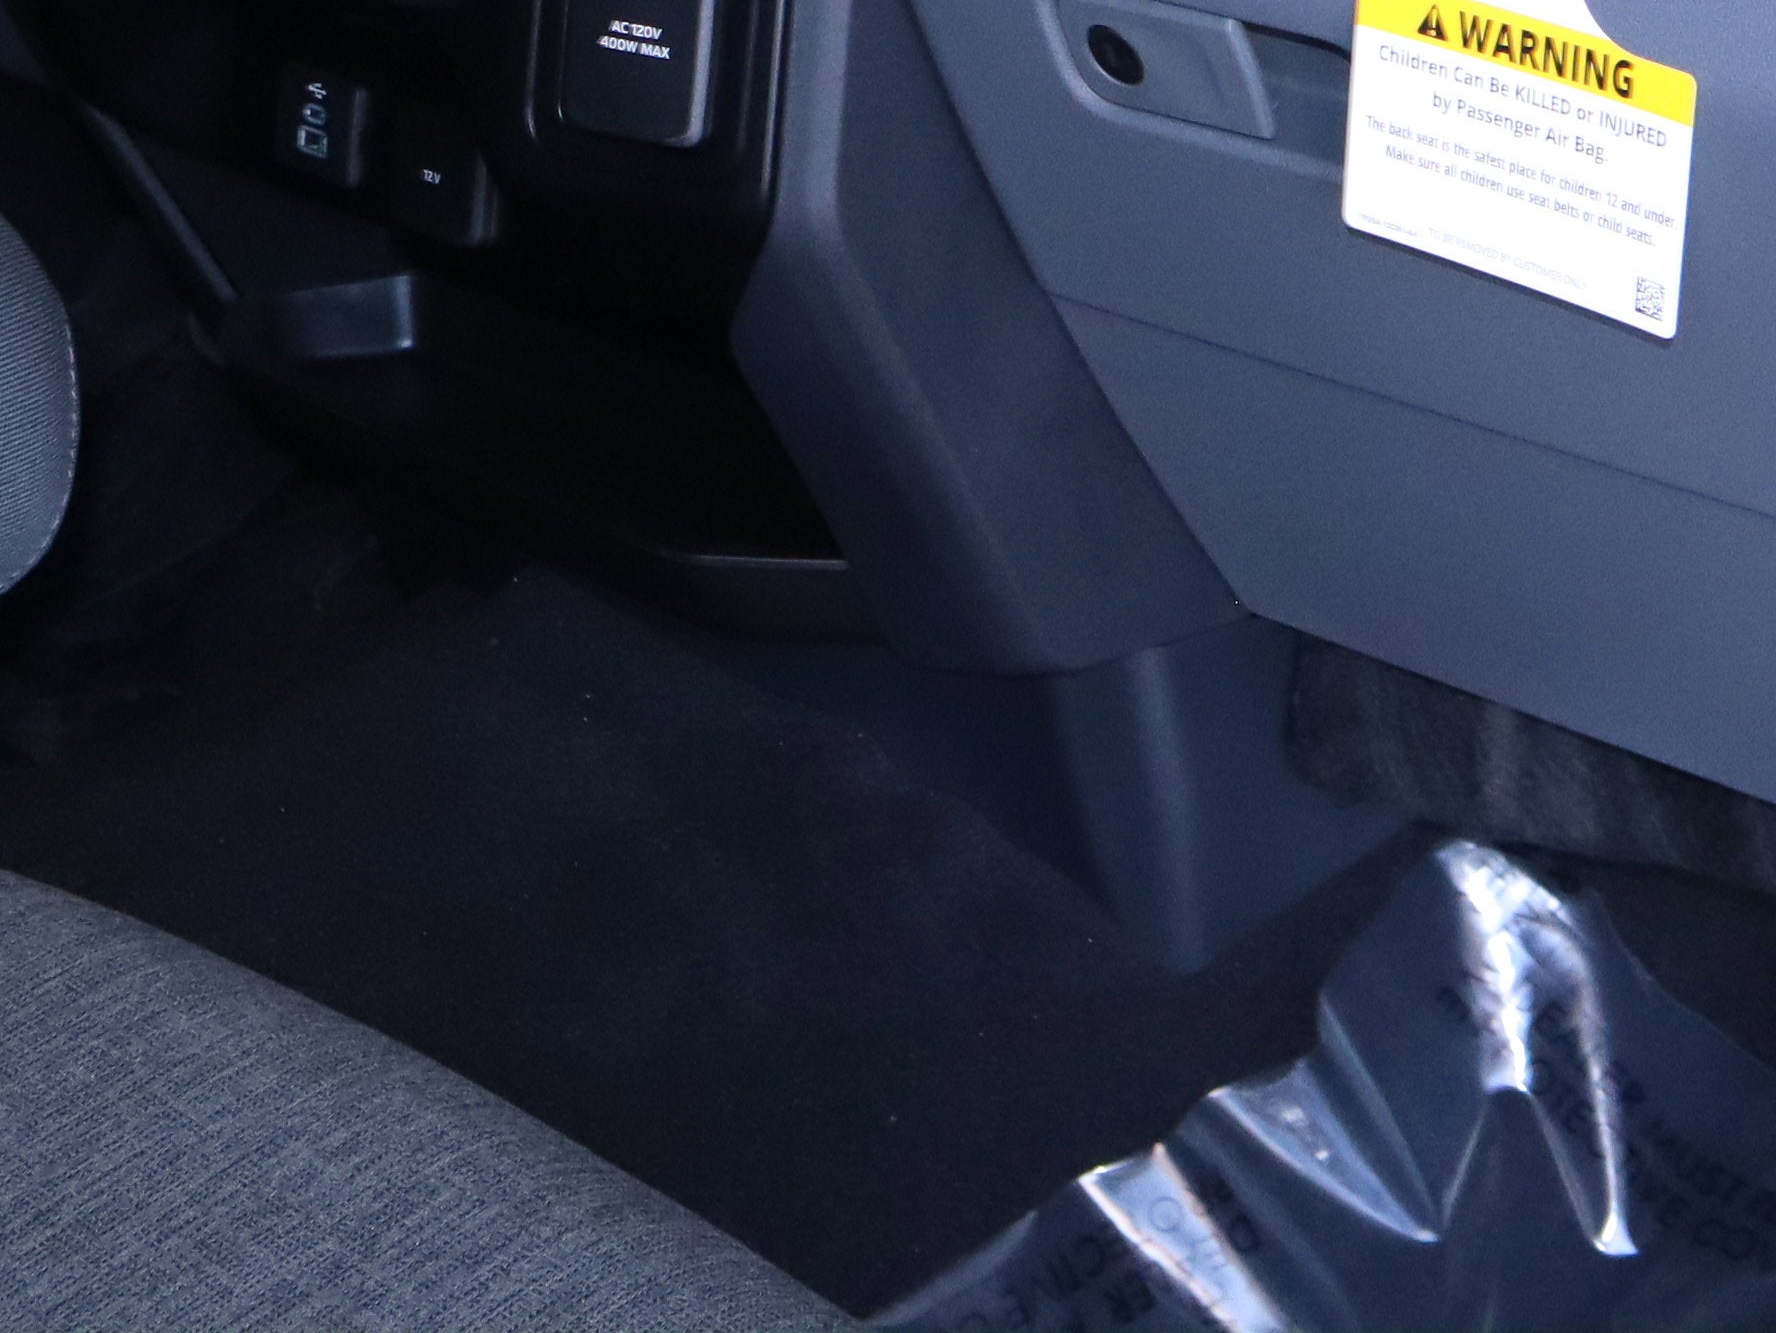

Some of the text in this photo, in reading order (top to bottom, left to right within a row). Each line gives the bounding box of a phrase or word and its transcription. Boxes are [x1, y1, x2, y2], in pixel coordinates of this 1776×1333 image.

[596, 36, 672, 60] 400W MAX
[607, 19, 664, 40] AC 120V
[1459, 9, 1636, 100] WARNING
[1378, 45, 1668, 149] Children Can Be KILLED or INJURED
[1433, 90, 1609, 165] by Passenger Air Bag.
[1366, 115, 1386, 133] The
[1389, 121, 1413, 143] back
[1417, 130, 1437, 149] seat
[1454, 142, 1471, 159] the
[1474, 148, 1506, 171] safest
[1509, 160, 1537, 182] place
[1540, 167, 1556, 186] for
[1559, 174, 1601, 203] children
[1605, 192, 1618, 208] 12
[1621, 197, 1641, 216] and
[1385, 144, 1415, 165] Make
[1417, 156, 1442, 174] sure
[1444, 161, 1457, 177] all
[1460, 167, 1504, 195] children
[1506, 185, 1525, 201] use
[1528, 191, 1551, 209] seat
[1554, 196, 1580, 219] belts
[1582, 209, 1594, 222] or
[1597, 213, 1623, 234] child
